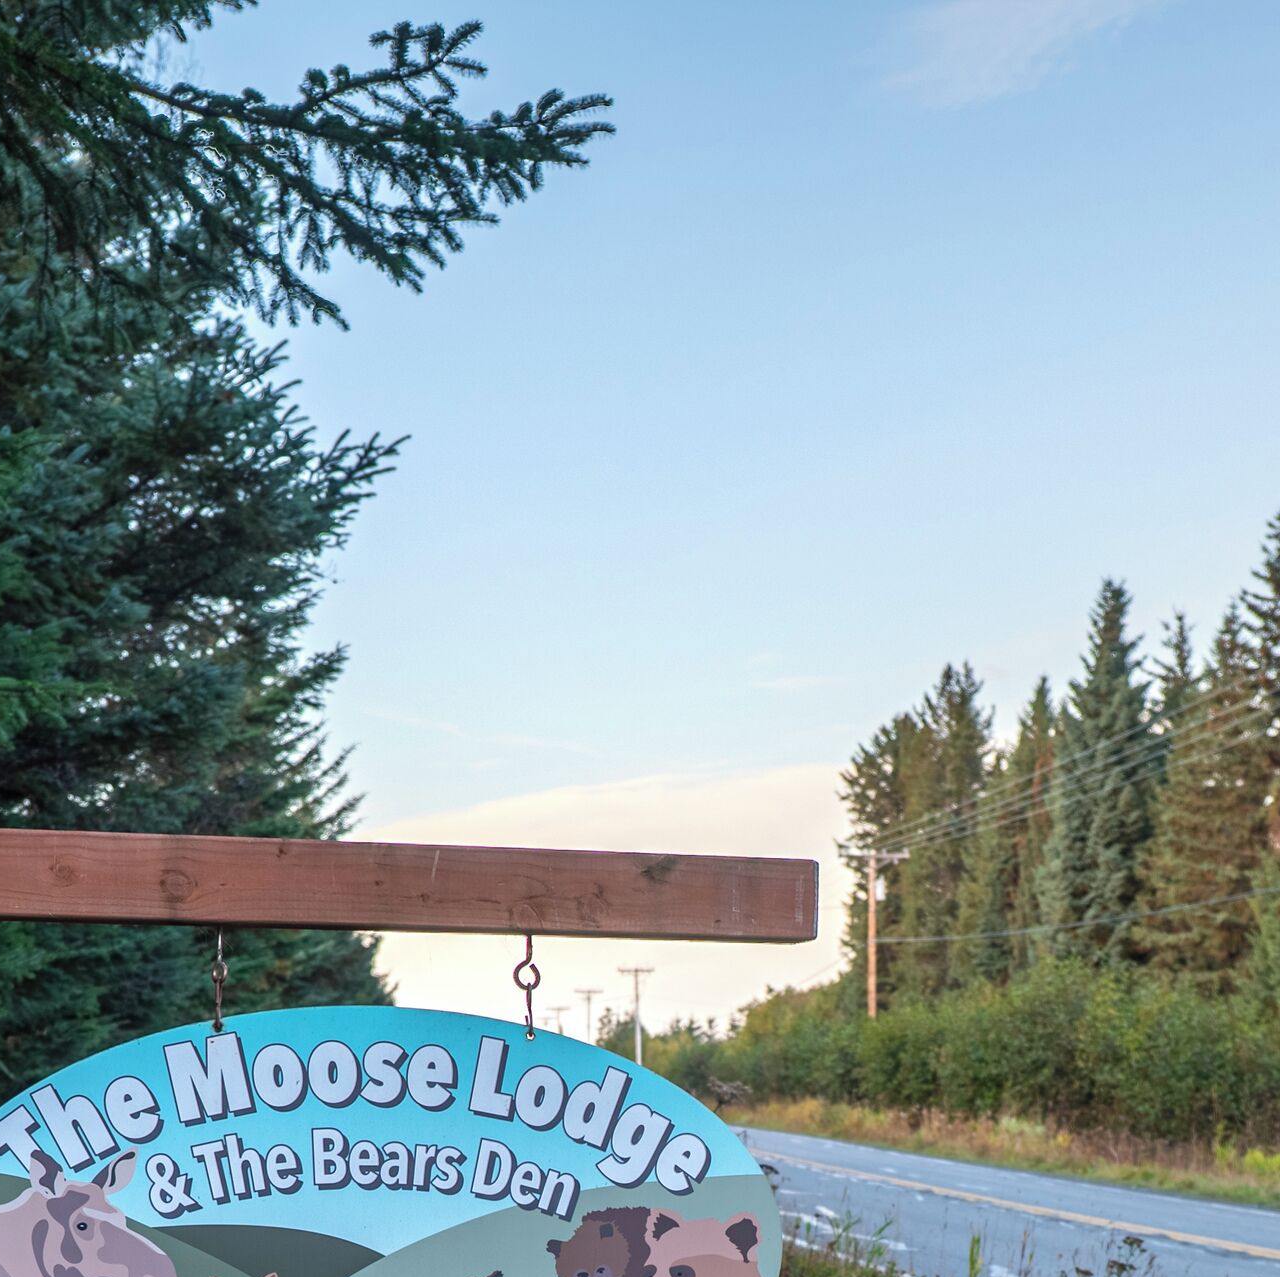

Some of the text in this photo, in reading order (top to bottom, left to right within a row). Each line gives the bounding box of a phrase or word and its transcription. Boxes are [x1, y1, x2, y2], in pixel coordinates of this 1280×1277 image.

[145, 1127, 581, 1222] & The Bears Den
[162, 1031, 459, 1128] Moose
[469, 1035, 711, 1197] Lodge
